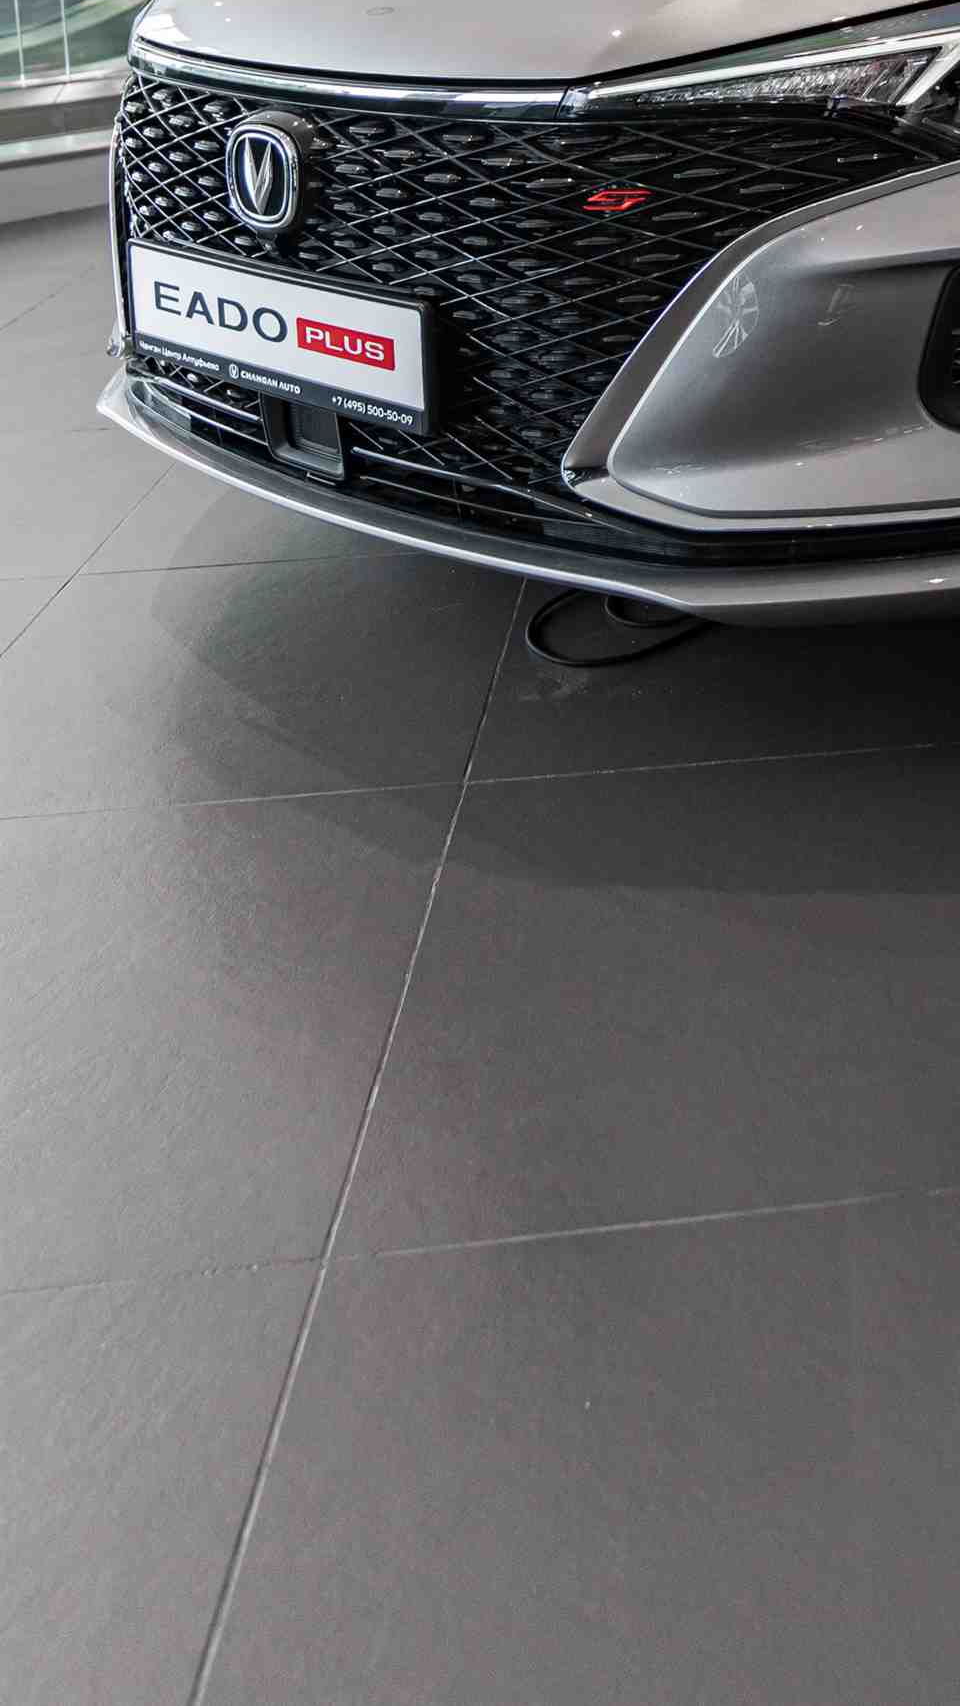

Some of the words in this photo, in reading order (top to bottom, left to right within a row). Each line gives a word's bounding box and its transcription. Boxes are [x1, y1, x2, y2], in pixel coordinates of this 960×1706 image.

[154, 280, 288, 343] EADO
[305, 325, 385, 362] PLUS
[240, 370, 279, 388] CHANGAN
[279, 380, 301, 395] AUTO
[332, 396, 343, 407] +7
[343, 398, 366, 415] (495)
[367, 404, 413, 426] 500-50-09
